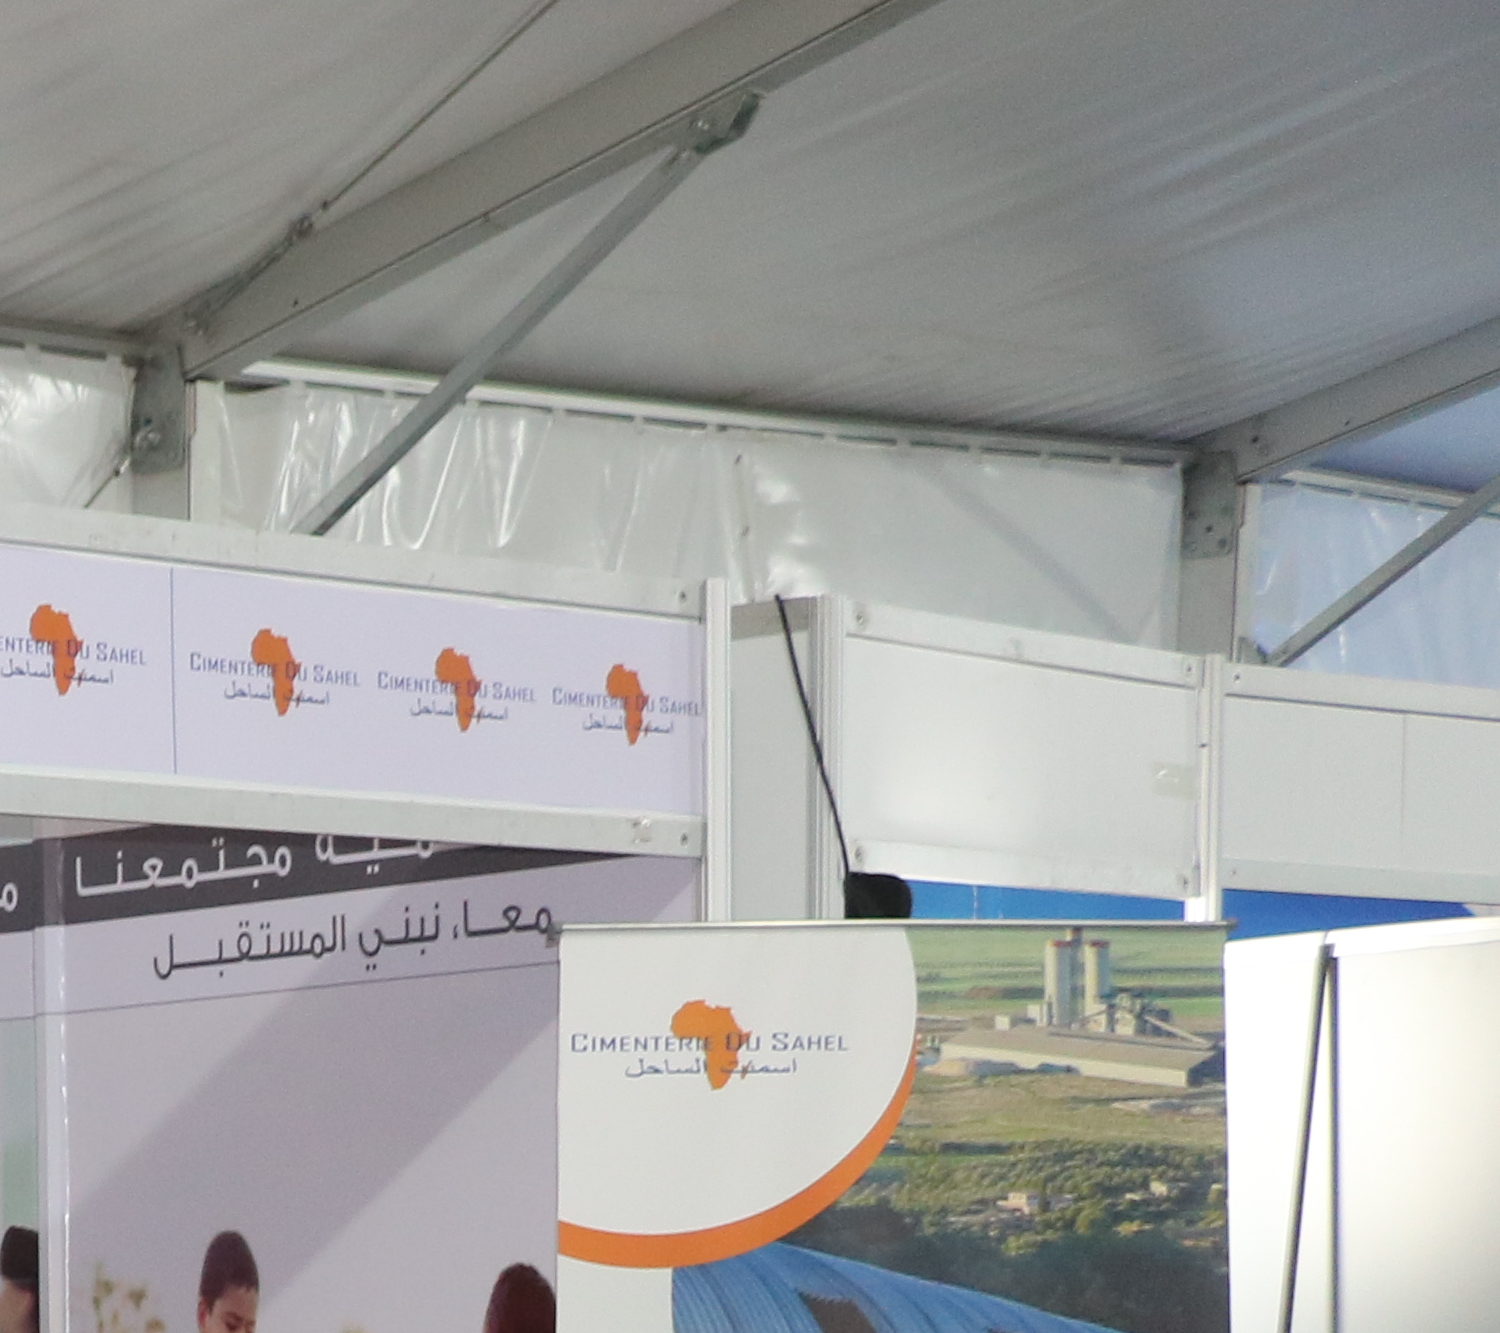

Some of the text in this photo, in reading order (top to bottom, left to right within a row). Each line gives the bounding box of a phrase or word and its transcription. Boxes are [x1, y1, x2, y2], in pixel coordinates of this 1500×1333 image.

[76, 838, 292, 897] مجتمعنا
[154, 914, 347, 979] المستقبل
[359, 902, 440, 971] نبني
